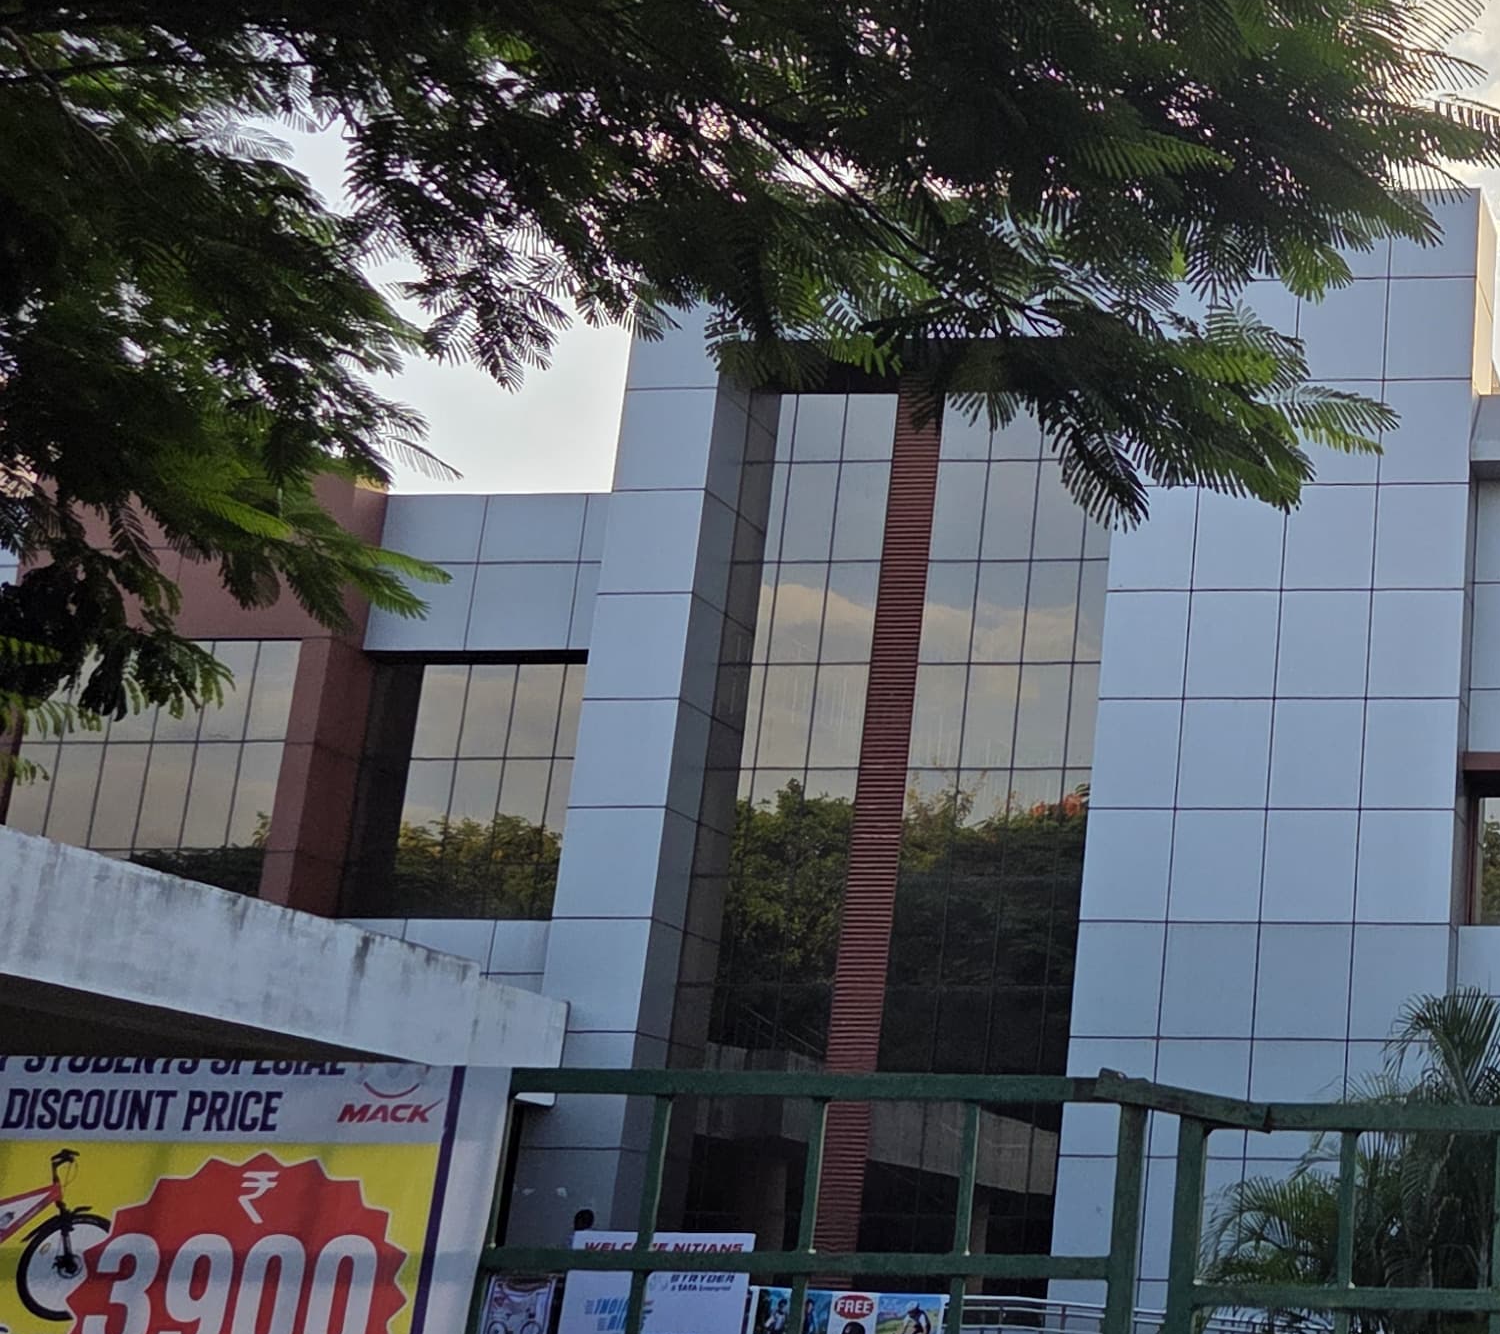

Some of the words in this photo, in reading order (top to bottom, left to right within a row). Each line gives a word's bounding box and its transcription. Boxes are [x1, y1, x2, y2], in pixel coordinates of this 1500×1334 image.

[1, 1088, 178, 1131] DISCOUNT
[182, 1090, 283, 1132] PRICE
[337, 1098, 443, 1123] MACK
[836, 1299, 871, 1313] FREE
